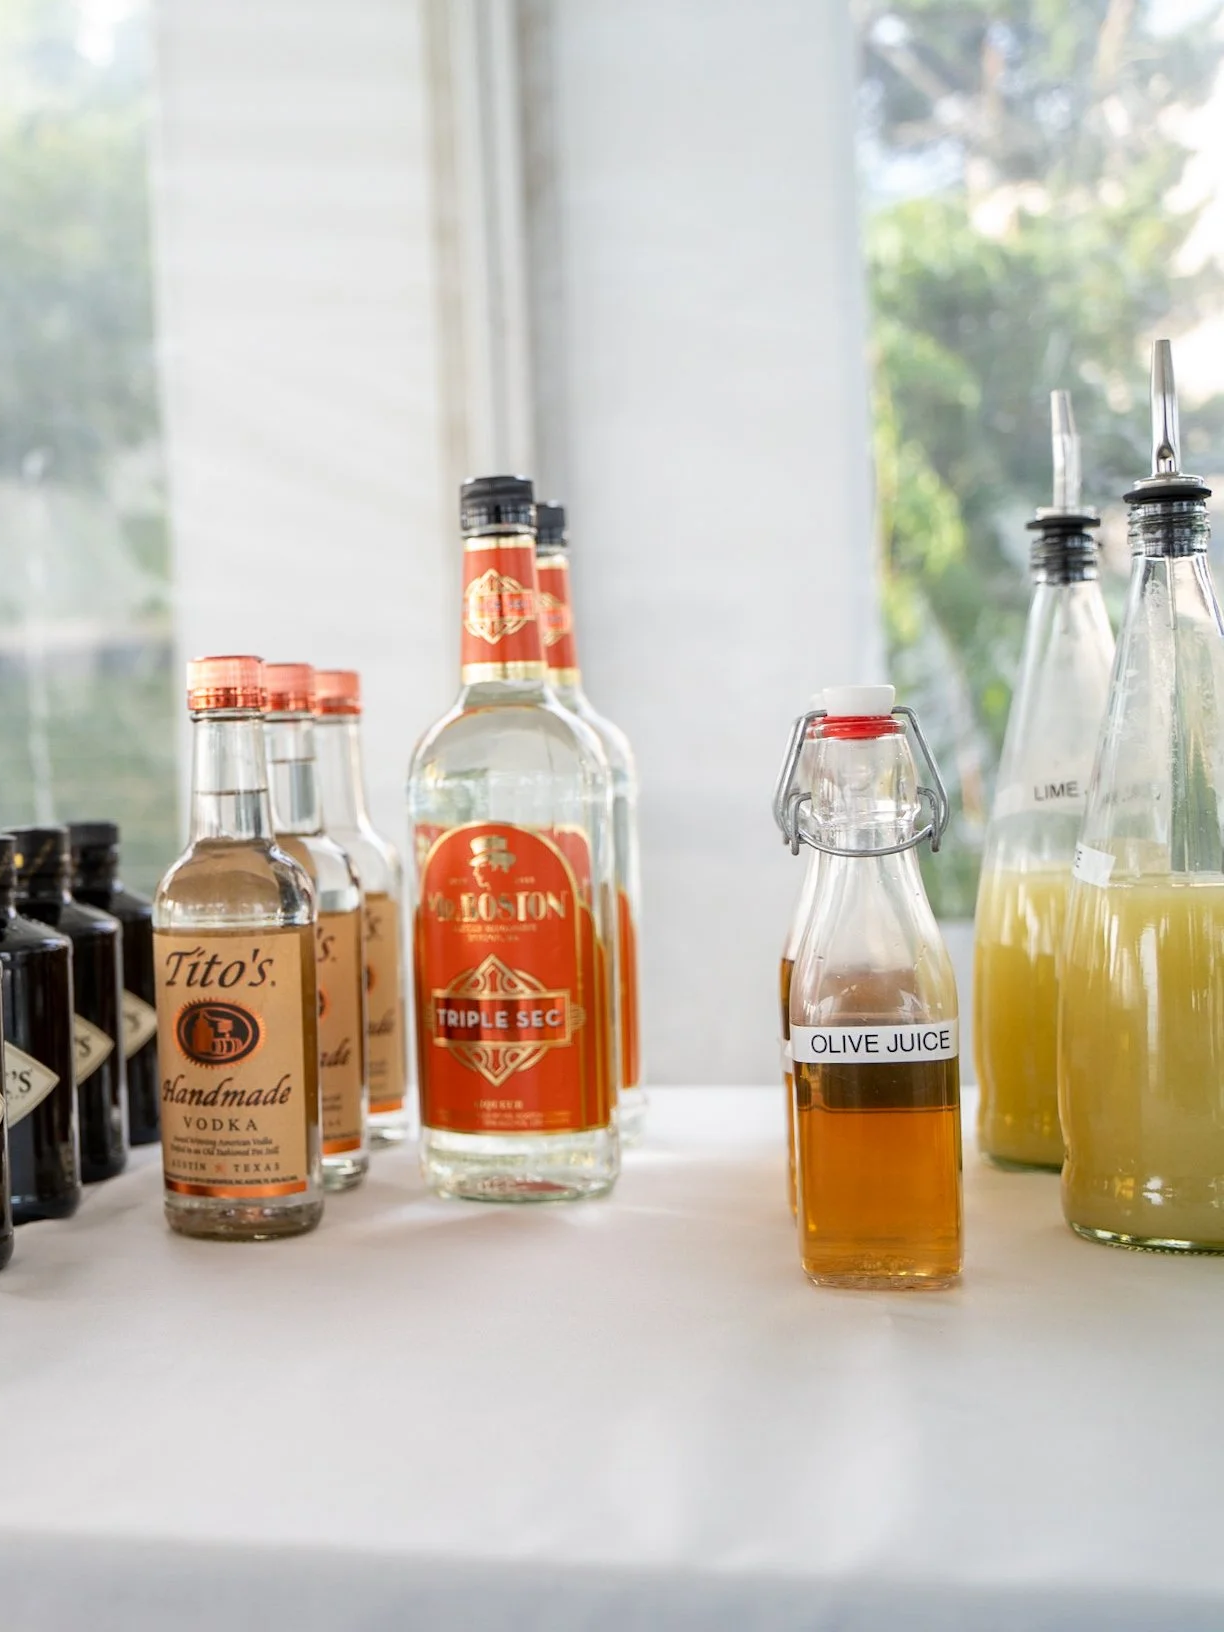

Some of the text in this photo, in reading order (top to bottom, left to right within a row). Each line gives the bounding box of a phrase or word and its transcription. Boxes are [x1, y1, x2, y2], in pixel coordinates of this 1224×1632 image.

[1034, 781, 1079, 801] LIME
[460, 890, 569, 923] BOSTON
[437, 1008, 563, 1029] TRIPLE SEC
[810, 1030, 950, 1053] OLIVE JUICE
[162, 1074, 292, 1108] Handmade
[182, 1116, 258, 1132] VODKA
[232, 1161, 281, 1173] TEXAS
